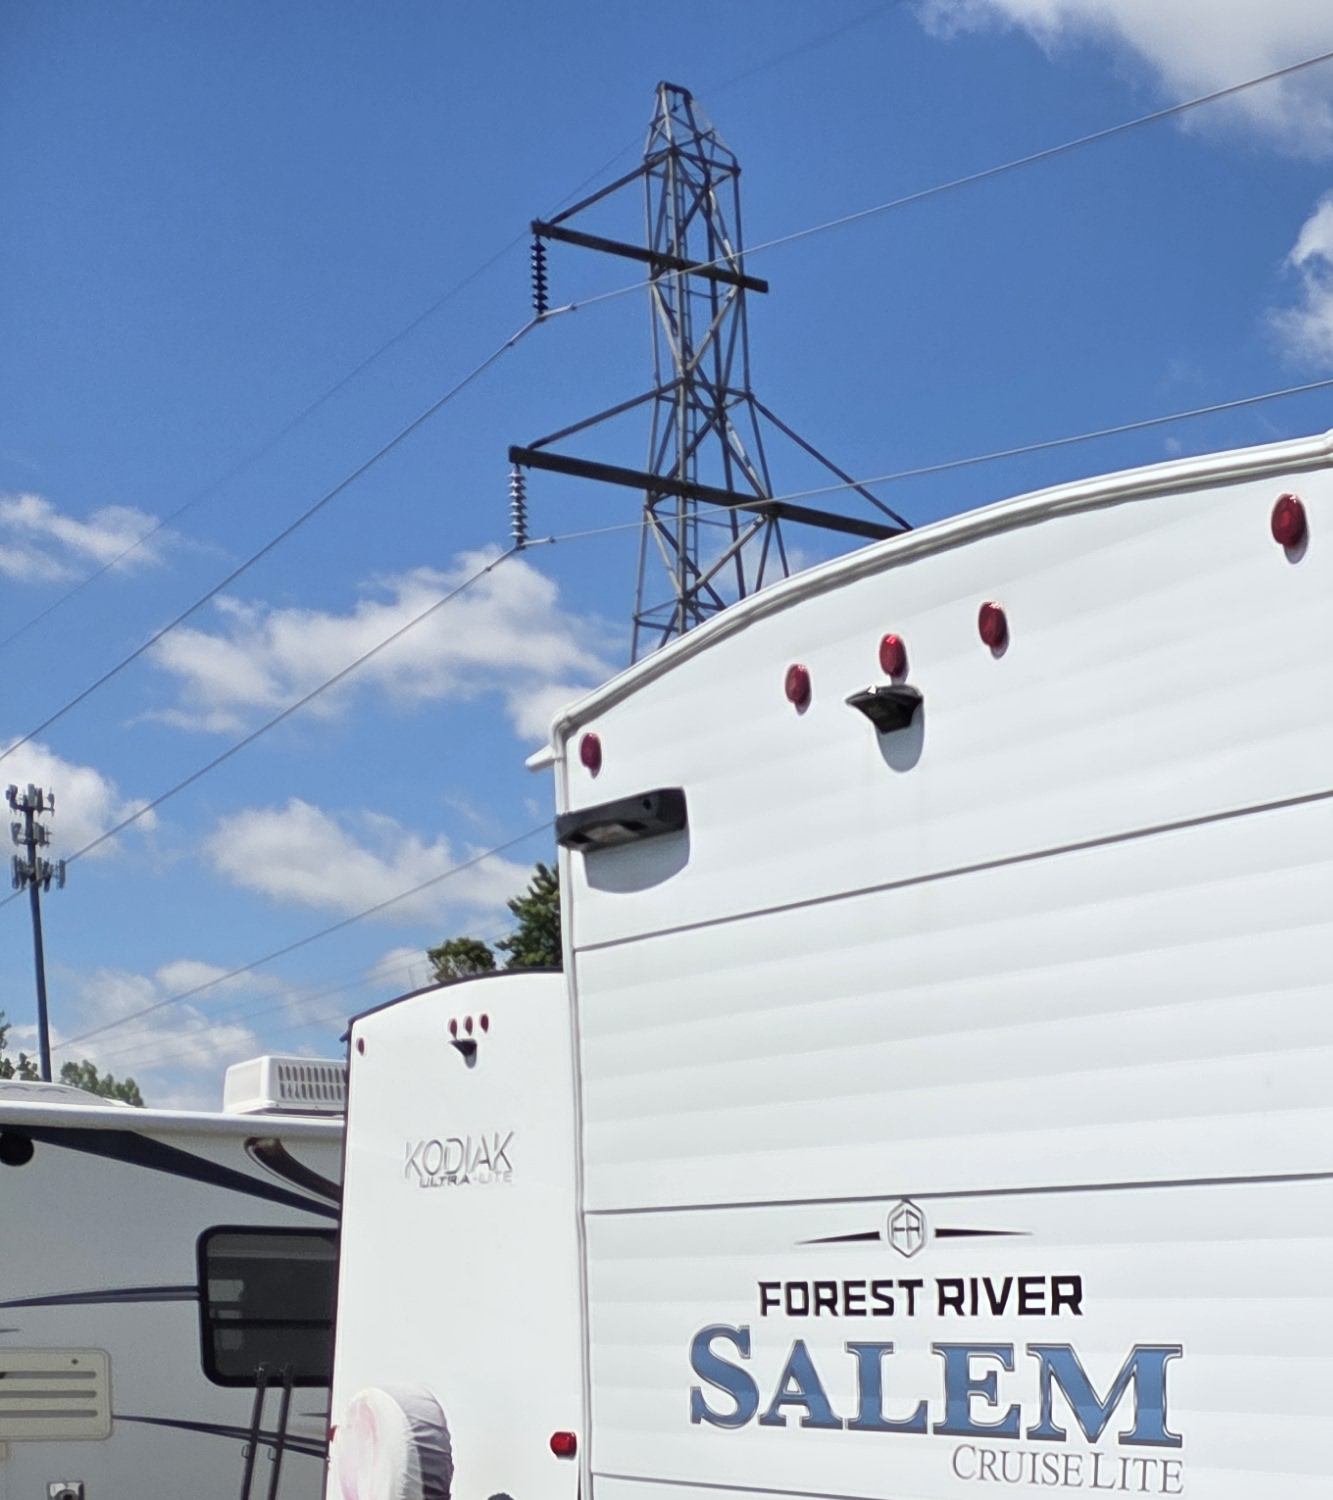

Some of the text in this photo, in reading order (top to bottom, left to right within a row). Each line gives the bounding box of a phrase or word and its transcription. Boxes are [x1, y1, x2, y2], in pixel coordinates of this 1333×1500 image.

[404, 1131, 514, 1179] KODIAK
[757, 1275, 1084, 1316] FOREST RIVER
[689, 1323, 1184, 1448] SALEM
